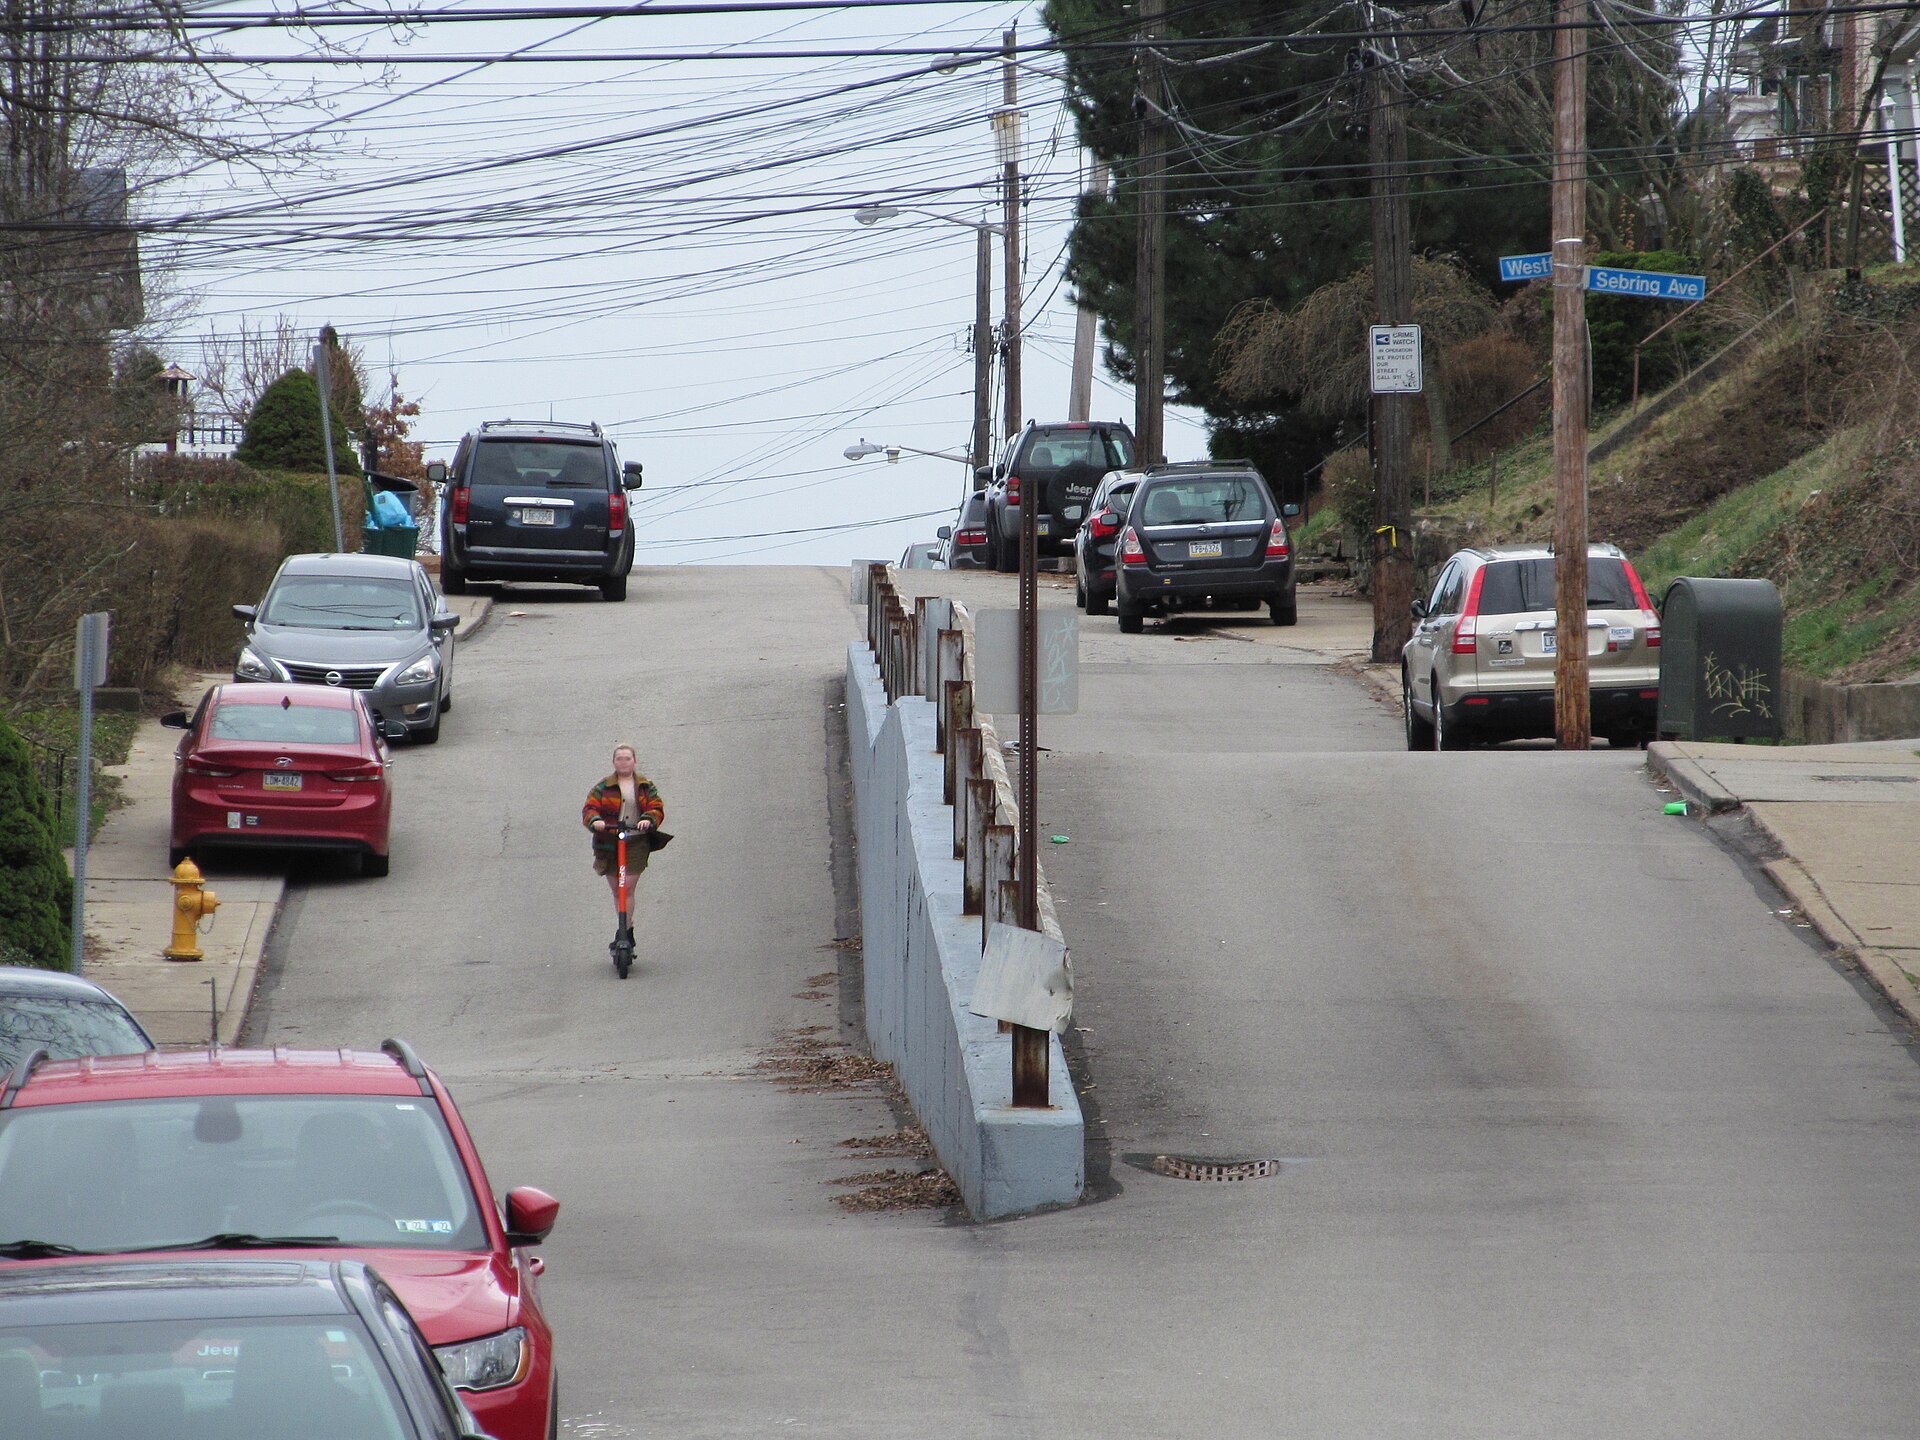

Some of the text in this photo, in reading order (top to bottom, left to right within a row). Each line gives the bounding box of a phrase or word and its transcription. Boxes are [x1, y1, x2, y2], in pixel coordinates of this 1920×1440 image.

[1596, 272, 1698, 296] Sebring Ave
[1066, 483, 1093, 495] Jeep
